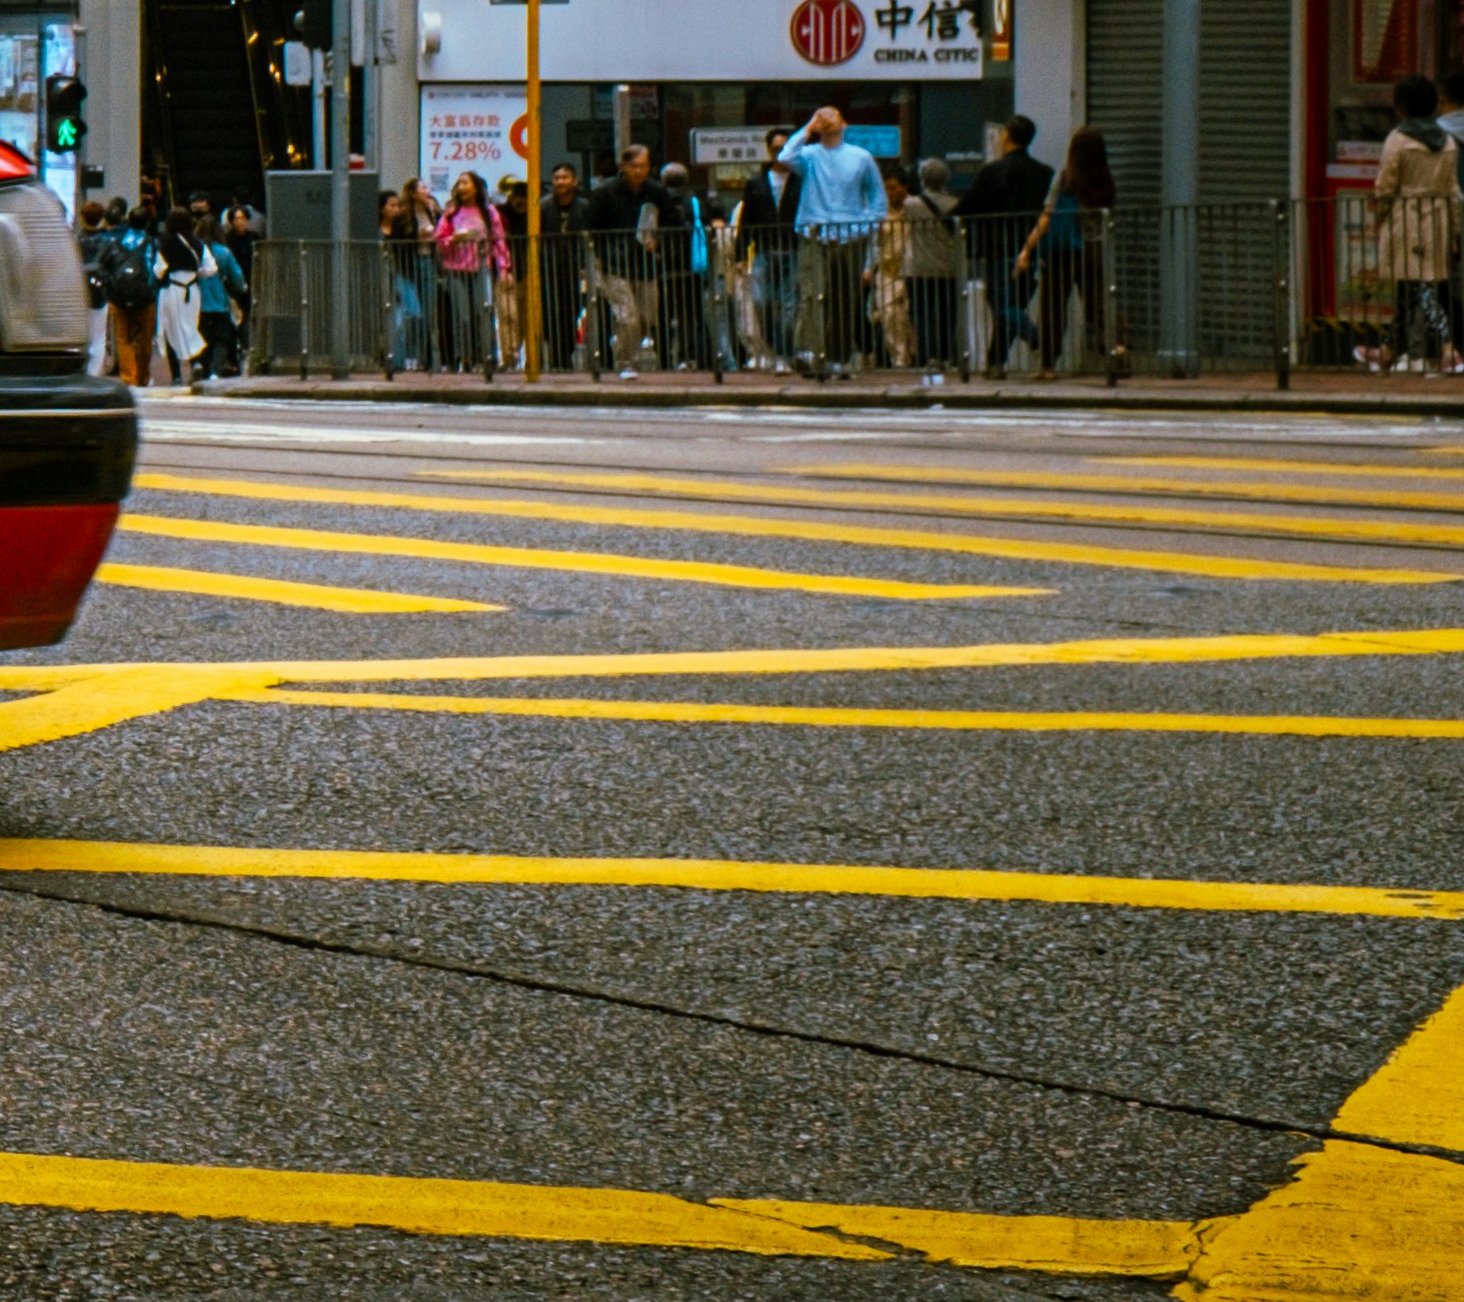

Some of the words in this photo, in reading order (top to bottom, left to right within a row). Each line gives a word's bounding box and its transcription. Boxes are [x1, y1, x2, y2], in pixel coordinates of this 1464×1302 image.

[874, 48, 928, 64] CHINA
[934, 47, 979, 63] CITIC
[429, 141, 502, 162] 7.28%
